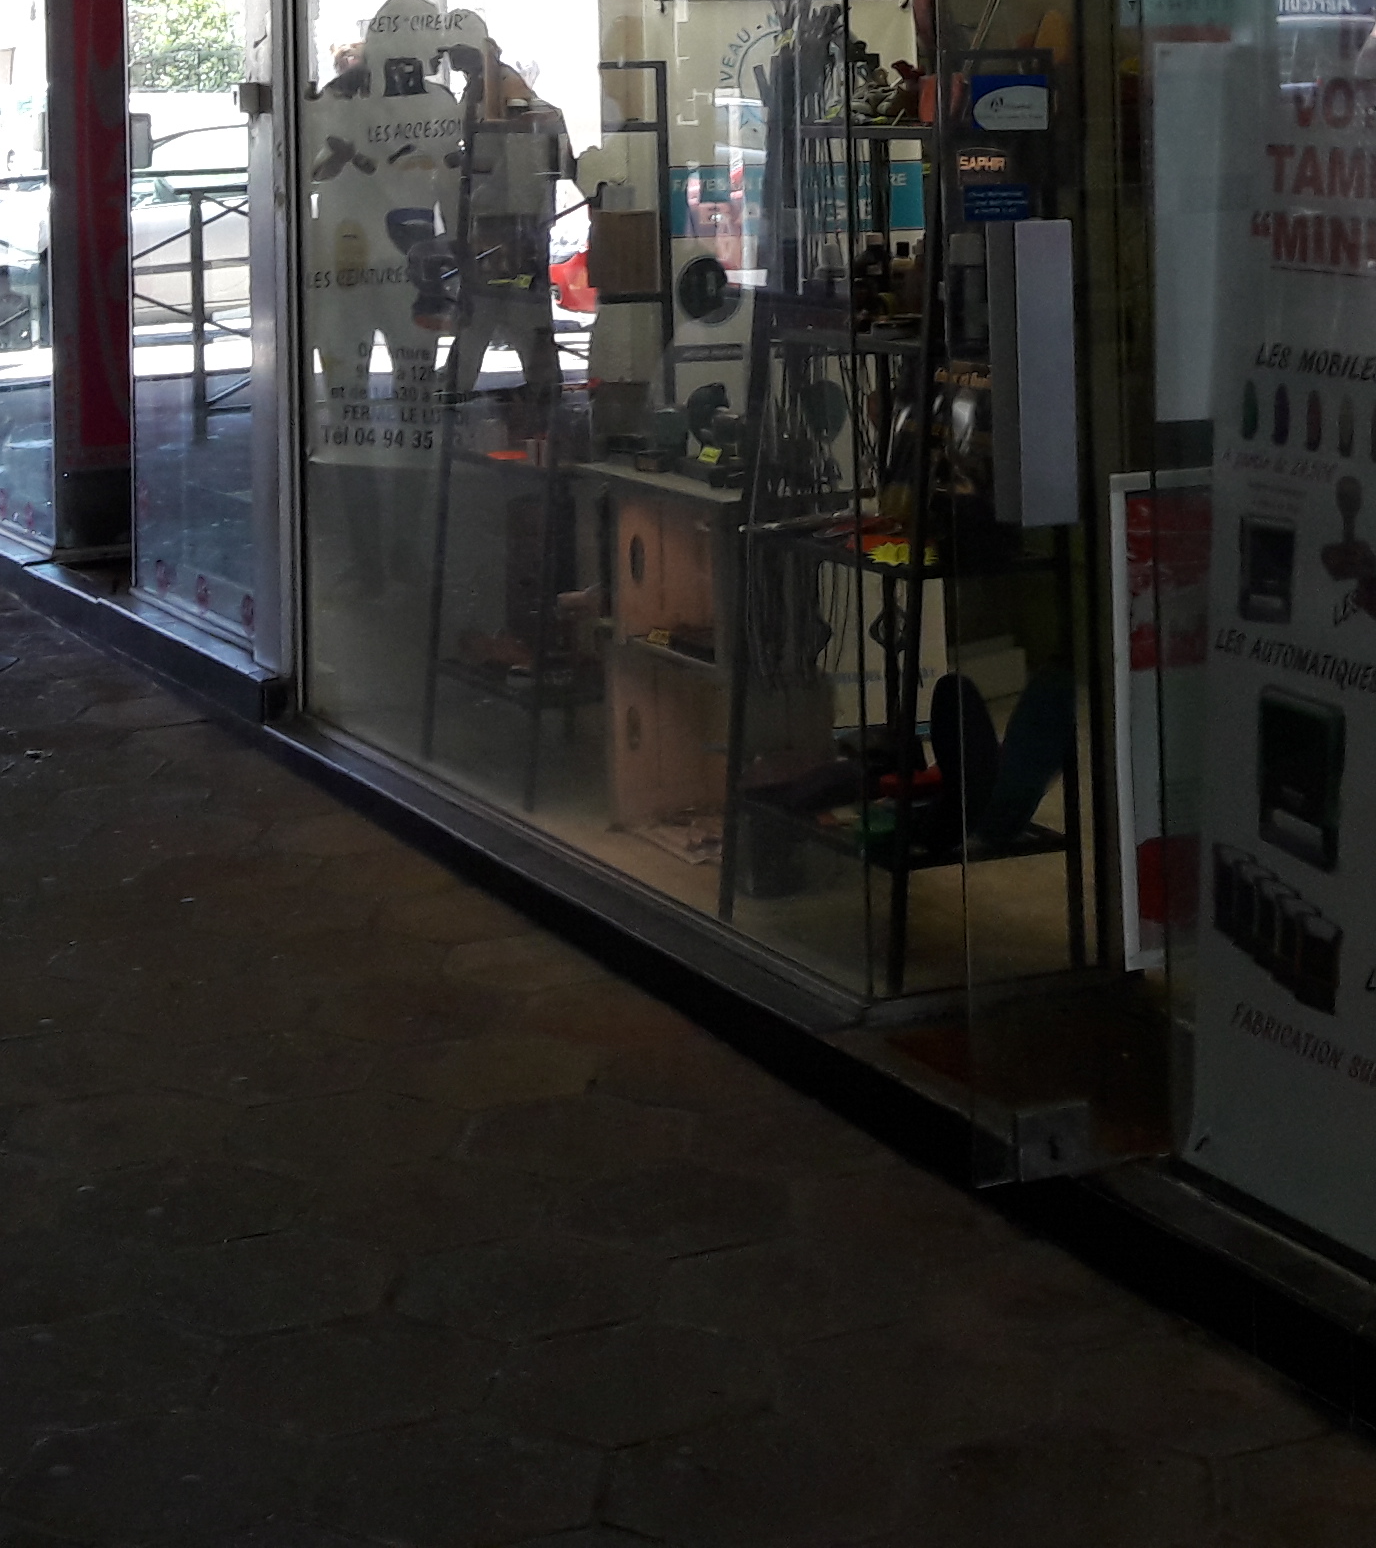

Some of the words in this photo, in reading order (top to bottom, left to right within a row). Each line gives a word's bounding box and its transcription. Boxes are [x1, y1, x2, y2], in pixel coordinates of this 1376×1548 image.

[368, 123, 391, 142] LES
[958, 155, 1008, 173] SAPHIR
[1254, 341, 1292, 370] LES
[1214, 628, 1248, 653] LES
[1229, 1000, 1346, 1070] FABRICATION
